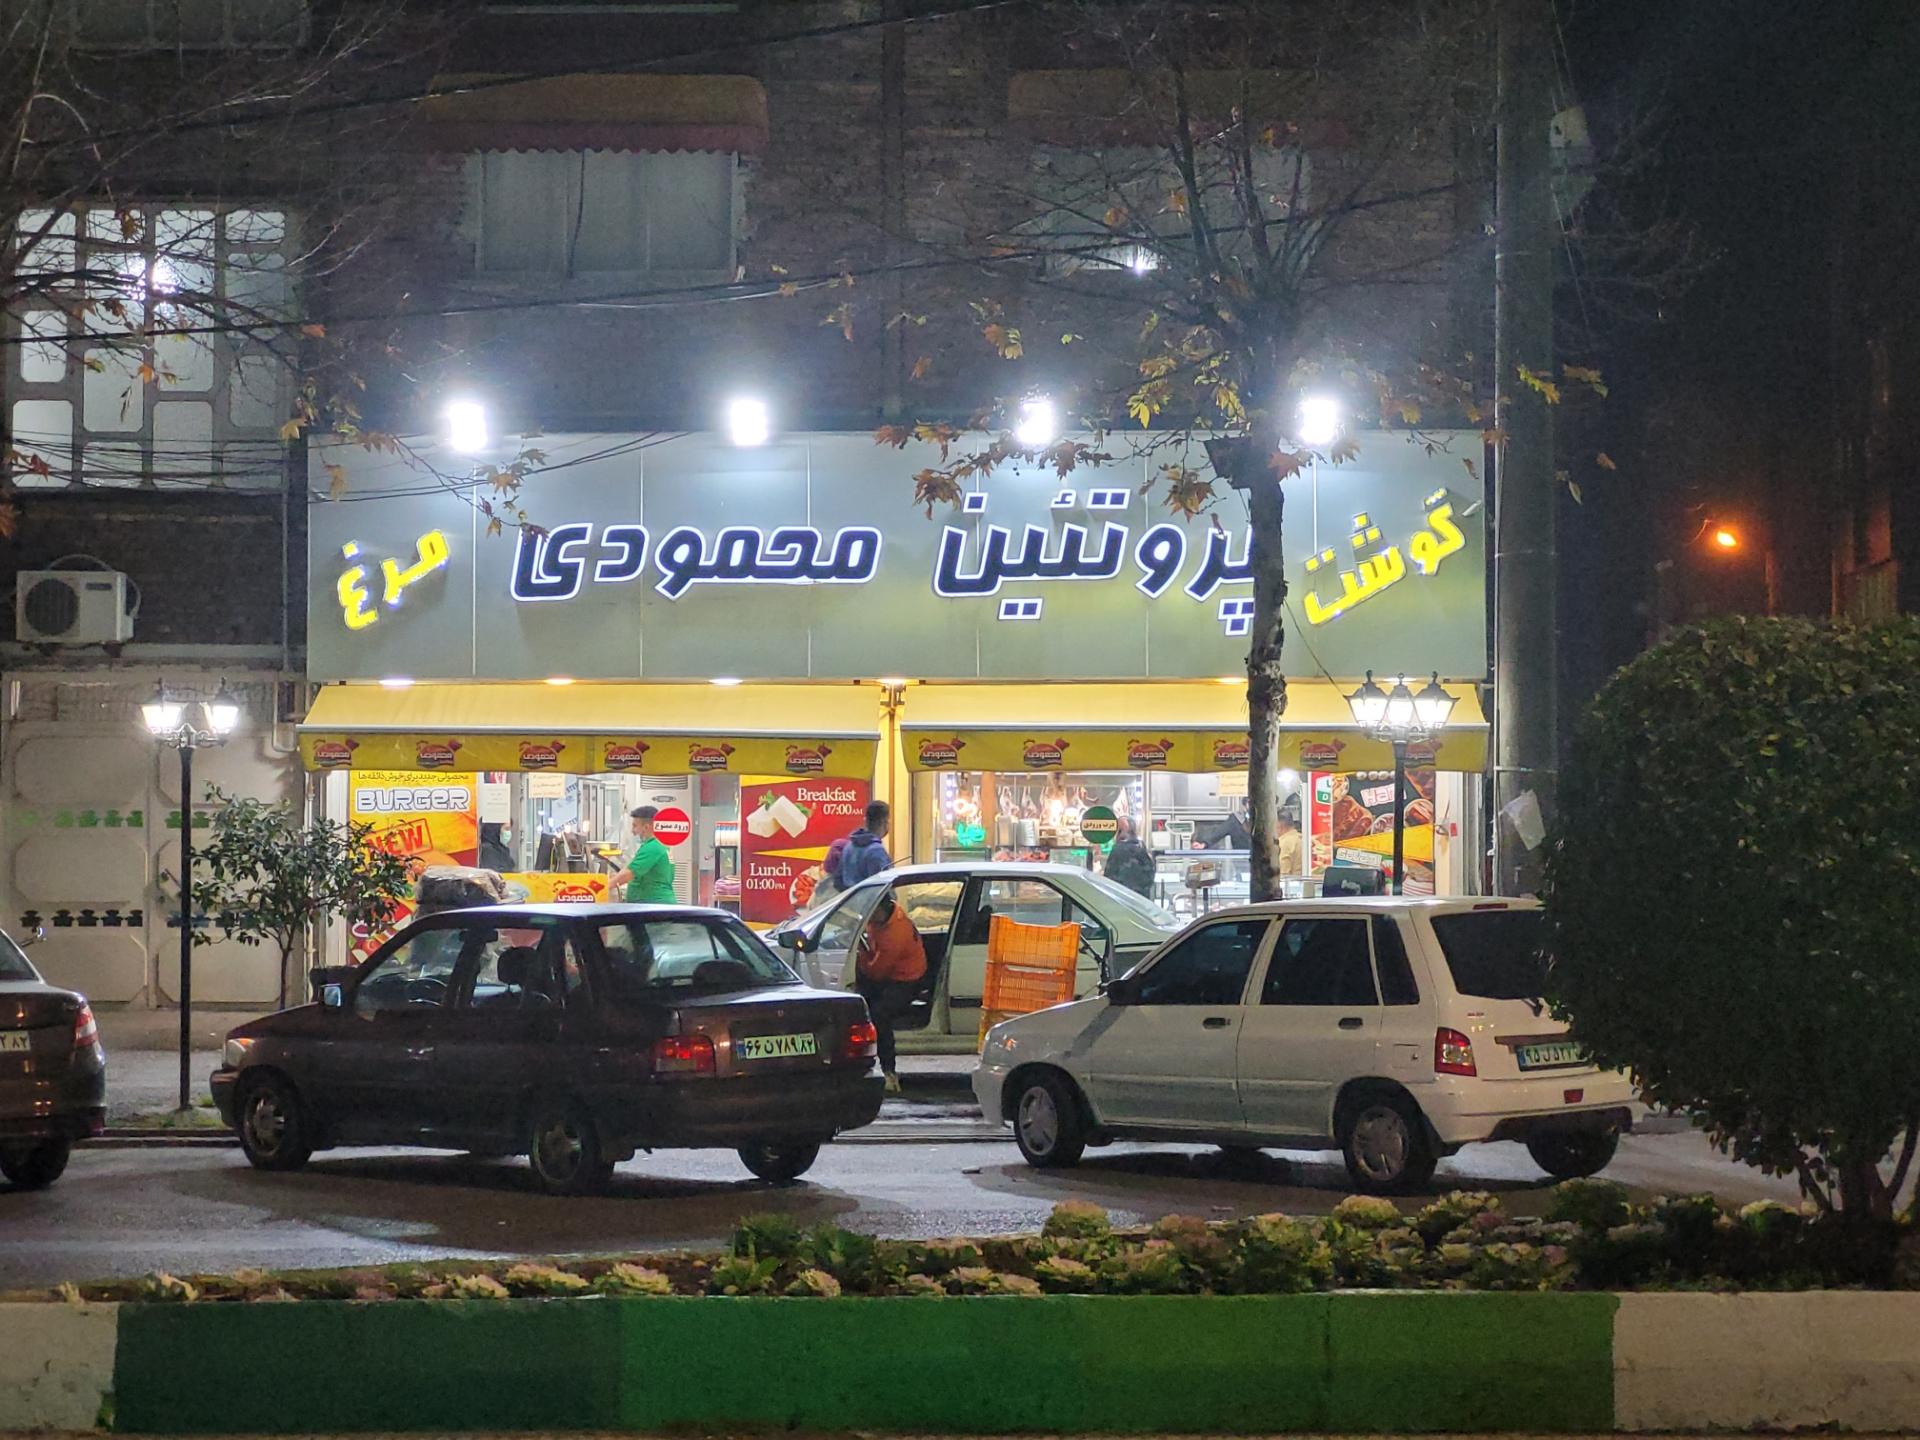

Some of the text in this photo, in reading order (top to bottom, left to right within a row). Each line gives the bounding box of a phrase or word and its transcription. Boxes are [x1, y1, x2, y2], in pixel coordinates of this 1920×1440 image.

[337, 529, 449, 630] مرغ
[511, 523, 883, 601] محمودی
[797, 787, 857, 802] Breakfast
[750, 863, 791, 877] Lunch
